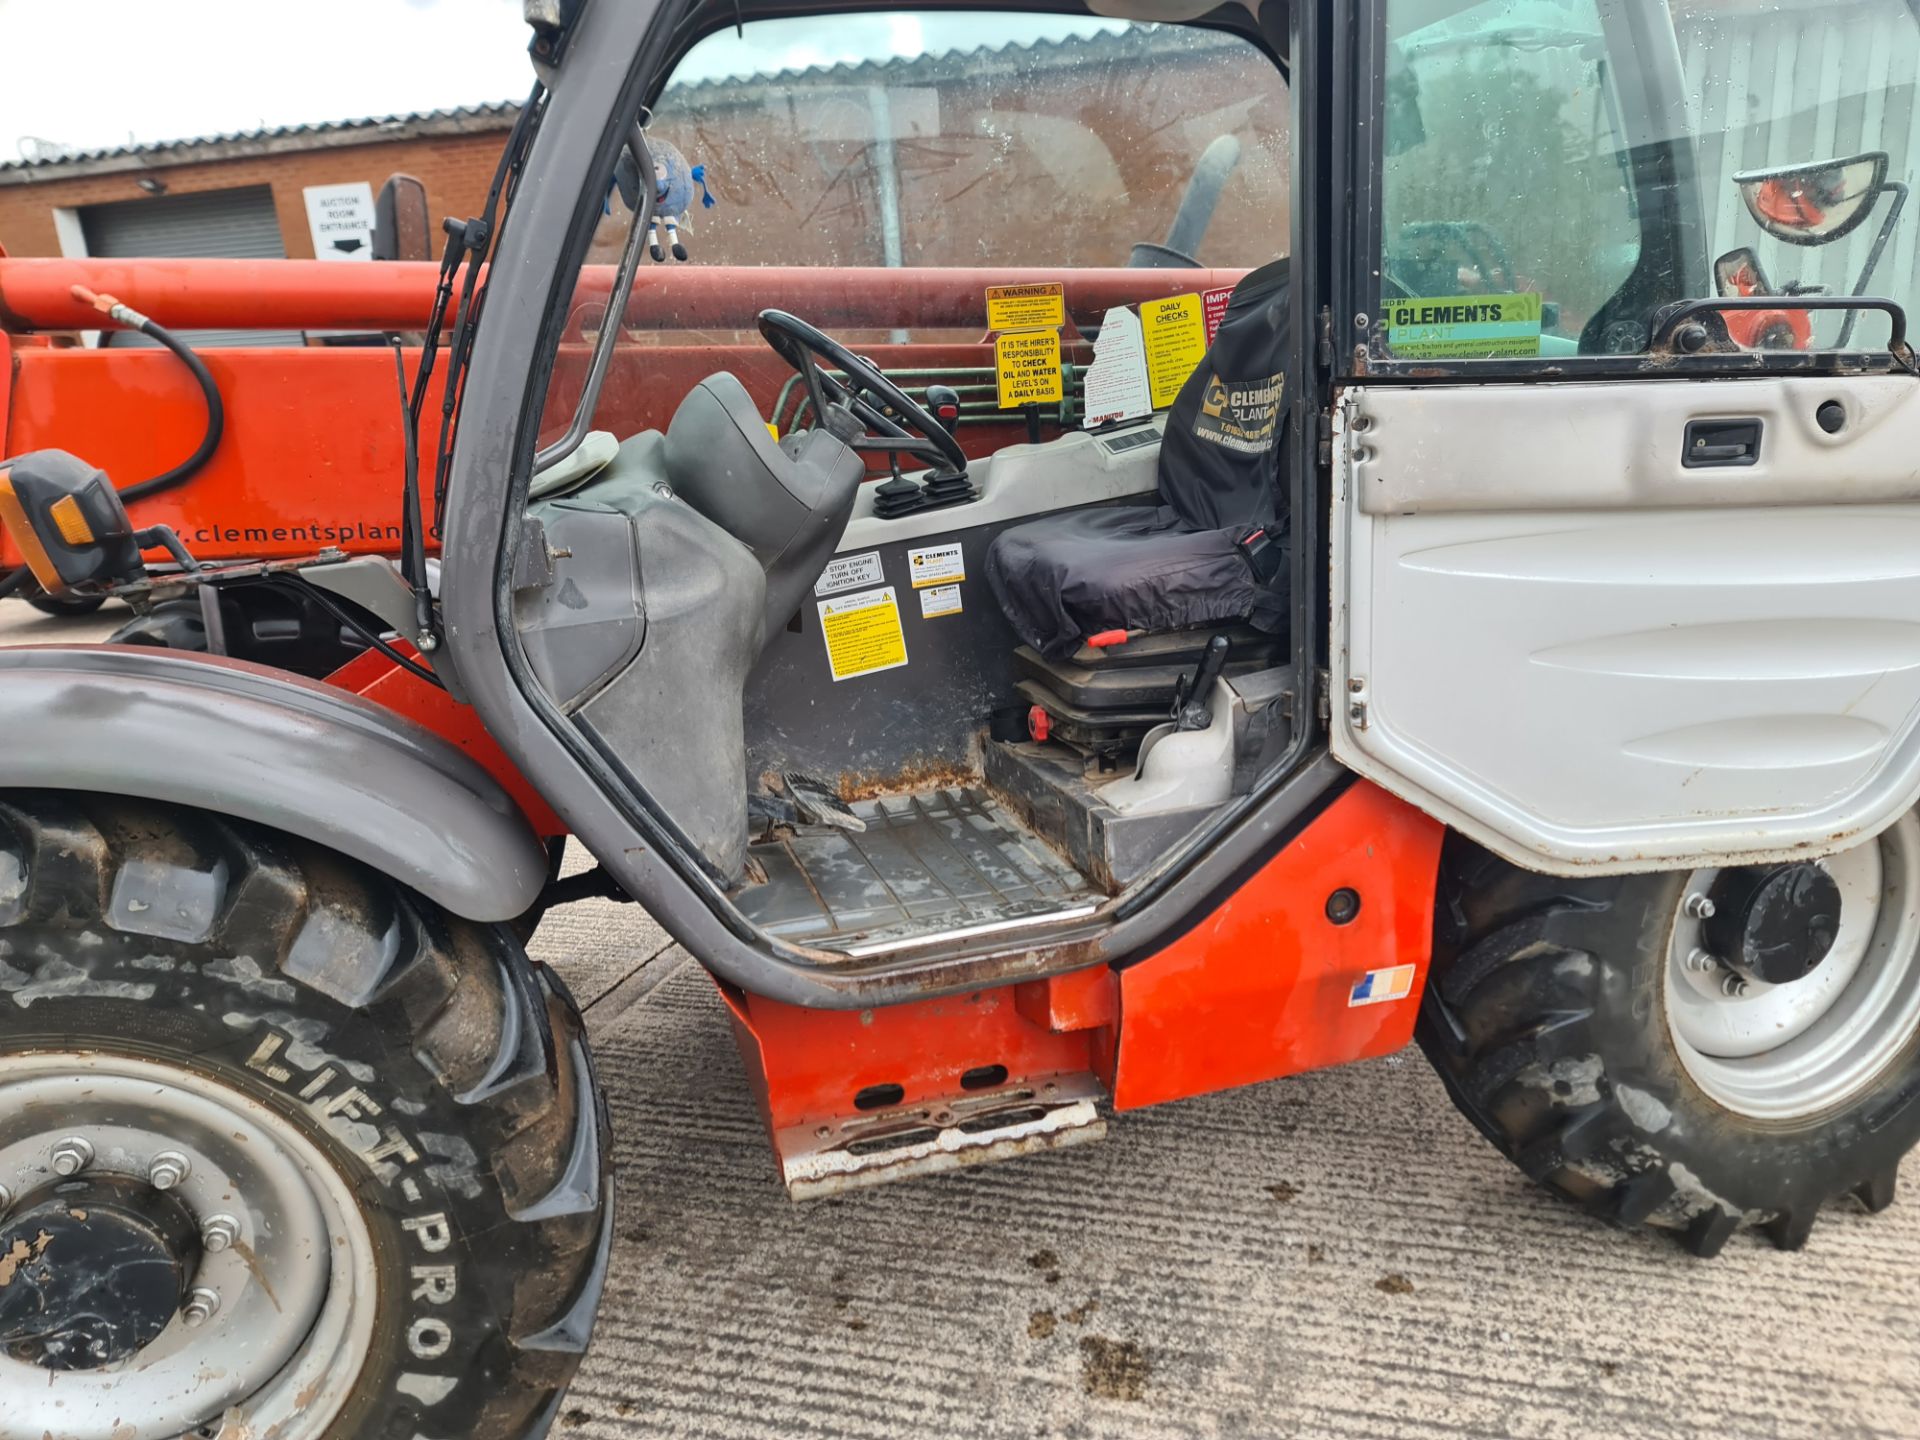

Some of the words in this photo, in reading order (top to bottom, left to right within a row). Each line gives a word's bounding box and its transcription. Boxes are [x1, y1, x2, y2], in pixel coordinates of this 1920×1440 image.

[328, 209, 355, 219] ROOM
[320, 220, 368, 232] ENTRANCE
[1002, 287, 1046, 297] WARNING
[1160, 302, 1181, 312] DAILY
[1155, 310, 1189, 323] CHECKS
[1395, 304, 1502, 325] CLEMENTS
[1397, 327, 1455, 340] PLANT
[1016, 340, 1028, 348] THE
[1030, 338, 1055, 346] HIRER'S
[1003, 348, 1054, 359] RESPONSIBILITY
[1022, 359, 1047, 367] CHECK
[1032, 368, 1057, 376] WATER
[1013, 379, 1038, 388] LEVEL'S
[1014, 389, 1034, 398] DAILY
[1036, 387, 1055, 395] BASIS
[925, 550, 958, 559] CLEMENTS
[829, 563, 847, 573] STOP
[849, 557, 873, 568] ENGINE
[831, 571, 849, 579] TURN
[851, 567, 864, 575] OFF
[826, 578, 856, 588] IGNITION
[857, 573, 871, 581] KEY
[246, 1031, 458, 1360] LIFT-PRO
